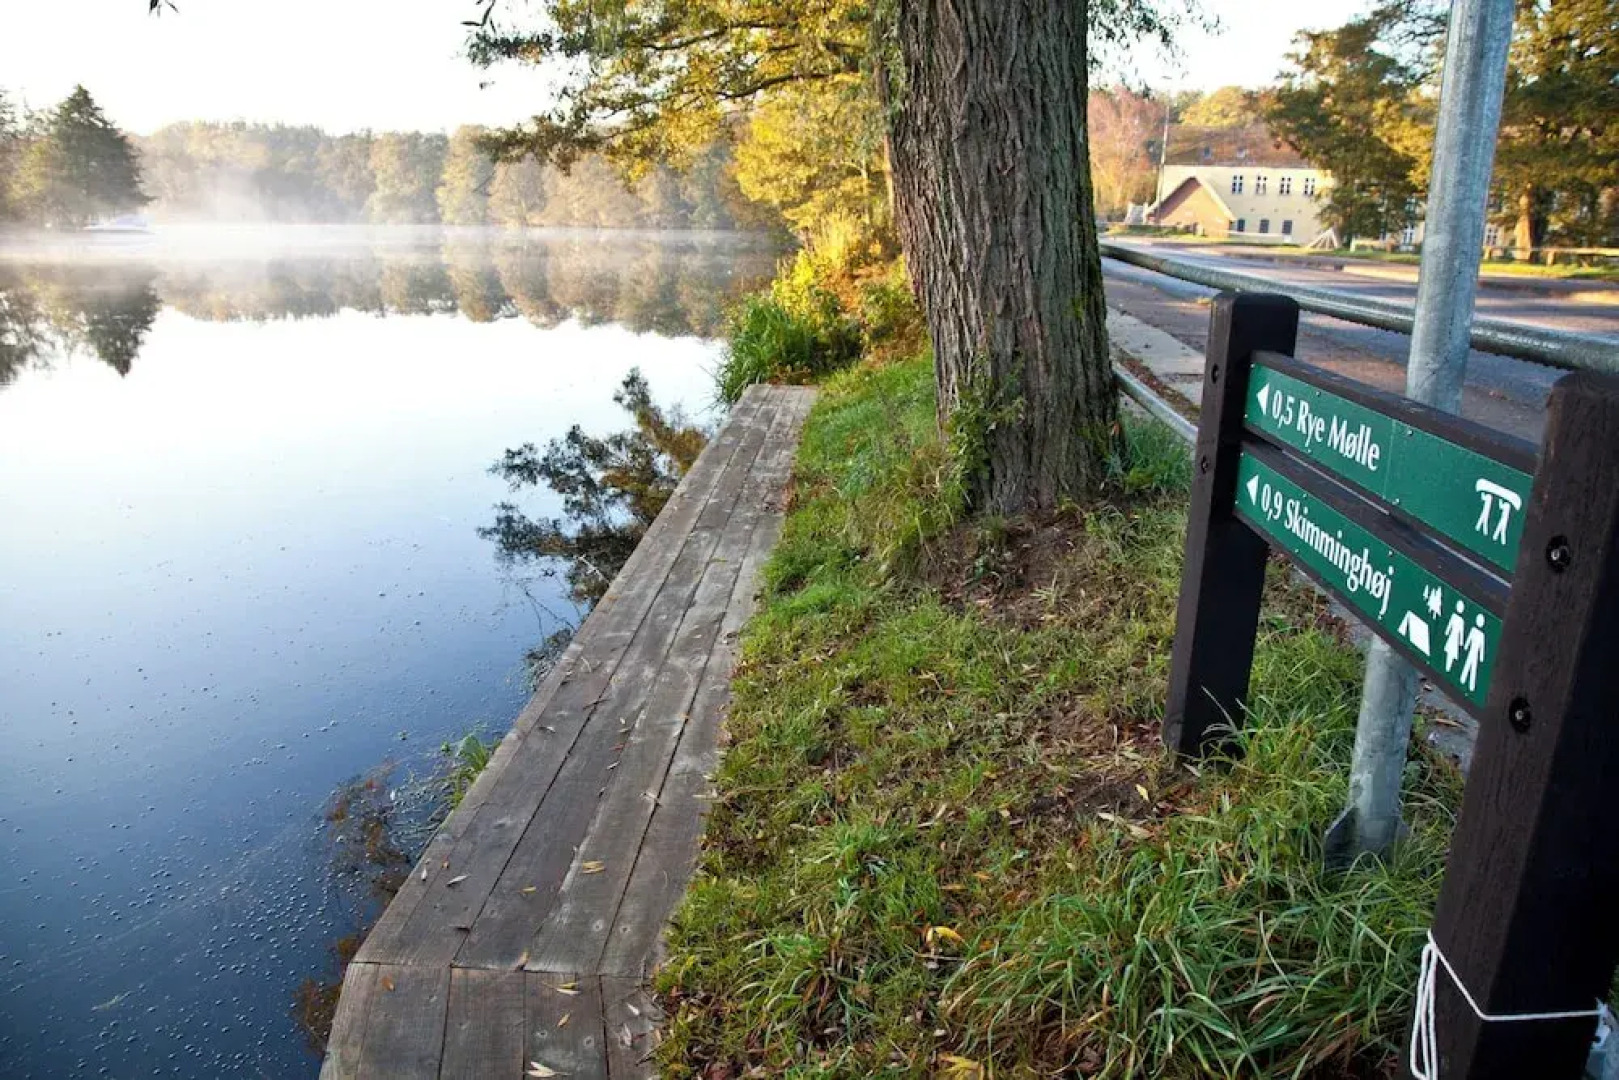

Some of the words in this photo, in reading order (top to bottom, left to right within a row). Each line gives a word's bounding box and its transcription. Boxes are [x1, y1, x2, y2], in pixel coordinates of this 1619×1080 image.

[1271, 389, 1293, 428] 0,5
[1296, 400, 1325, 446] Rye
[1327, 415, 1380, 471] Mølle
[1261, 484, 1283, 521] 0,9
[1284, 498, 1394, 615] Skimminghøj
